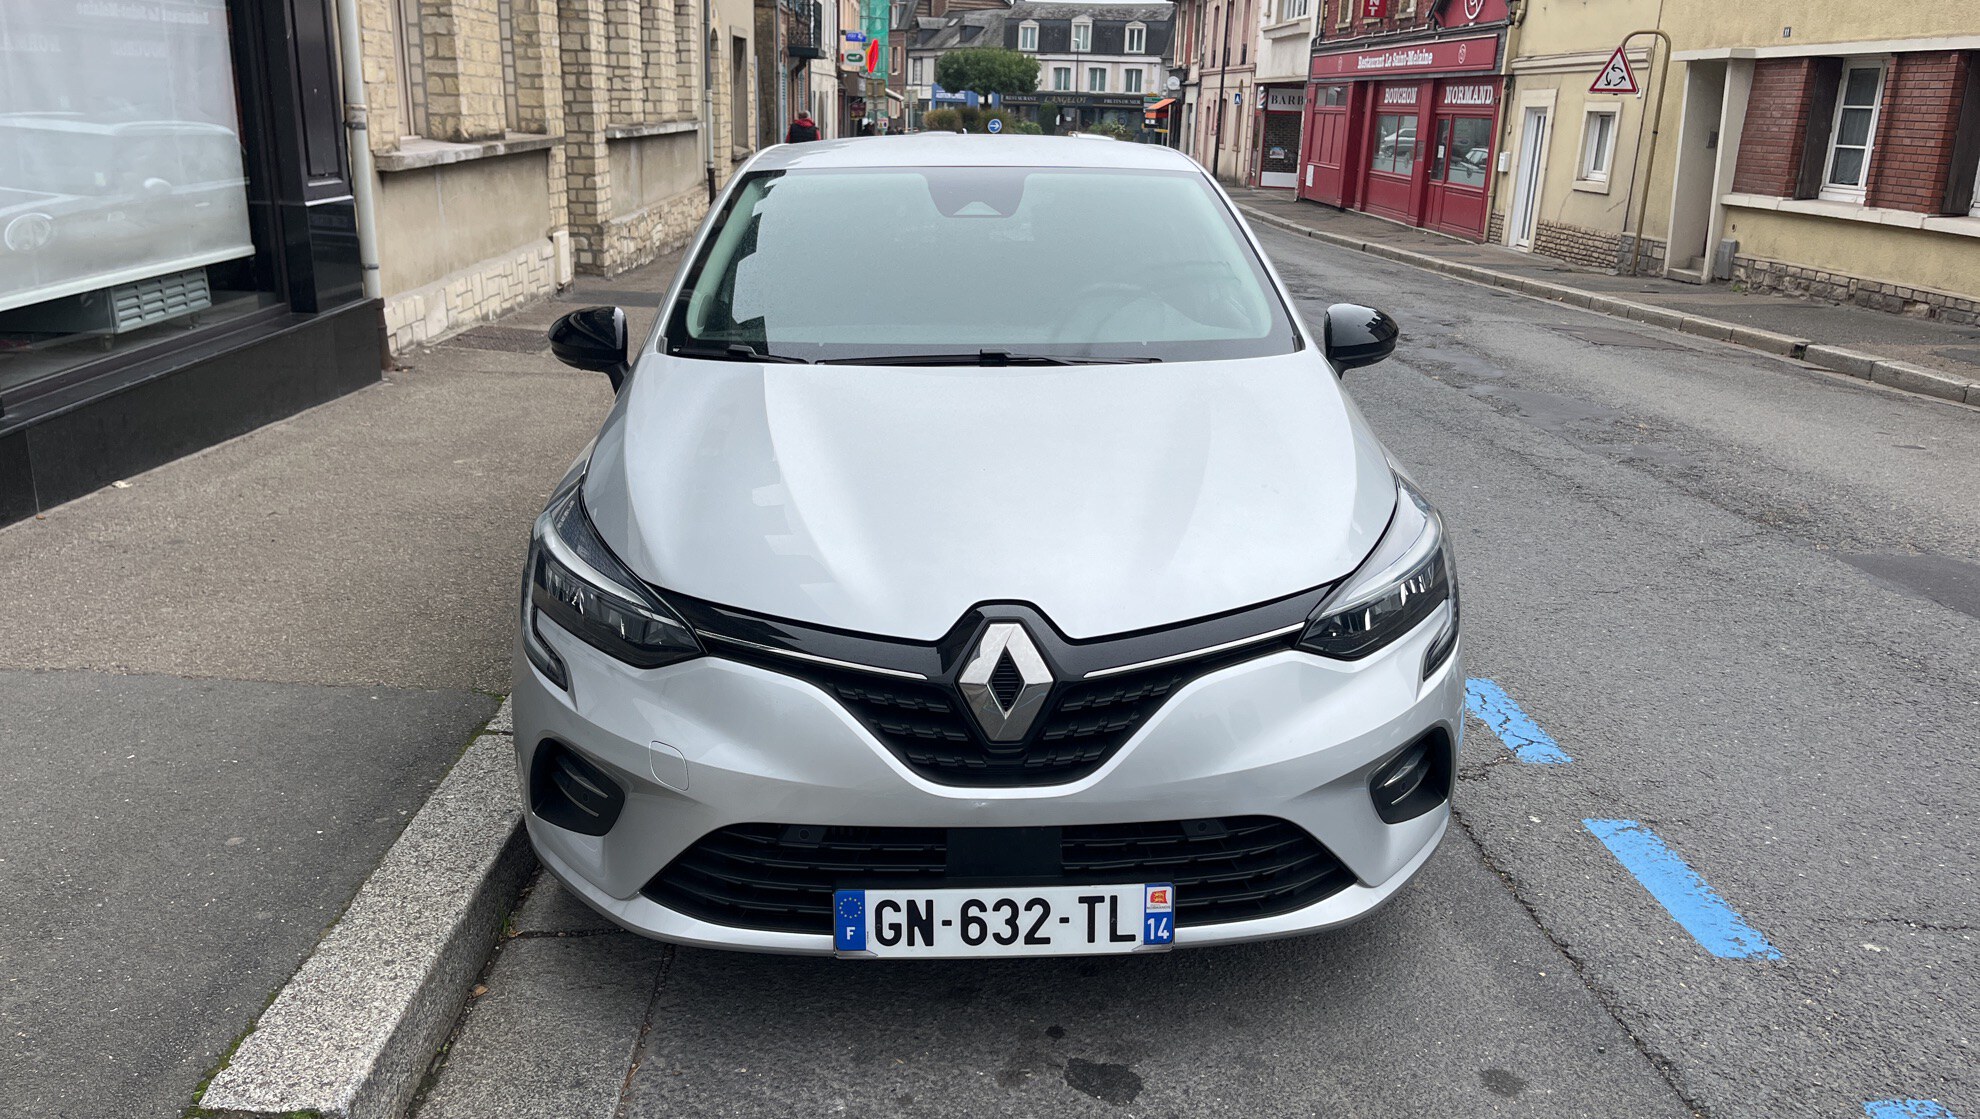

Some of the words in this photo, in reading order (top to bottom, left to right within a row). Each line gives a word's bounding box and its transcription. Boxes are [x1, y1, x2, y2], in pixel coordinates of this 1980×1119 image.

[1357, 54, 1385, 69] Restaurant
[1385, 53, 1392, 67] Le
[1392, 48, 1433, 66] Saint-Melaine
[1384, 87, 1417, 104] BOUCHON
[1444, 85, 1494, 104] NORMAND
[874, 895, 1136, 946] GN-632-TL
[1147, 917, 1170, 940] 14
[846, 926, 855, 940] F
